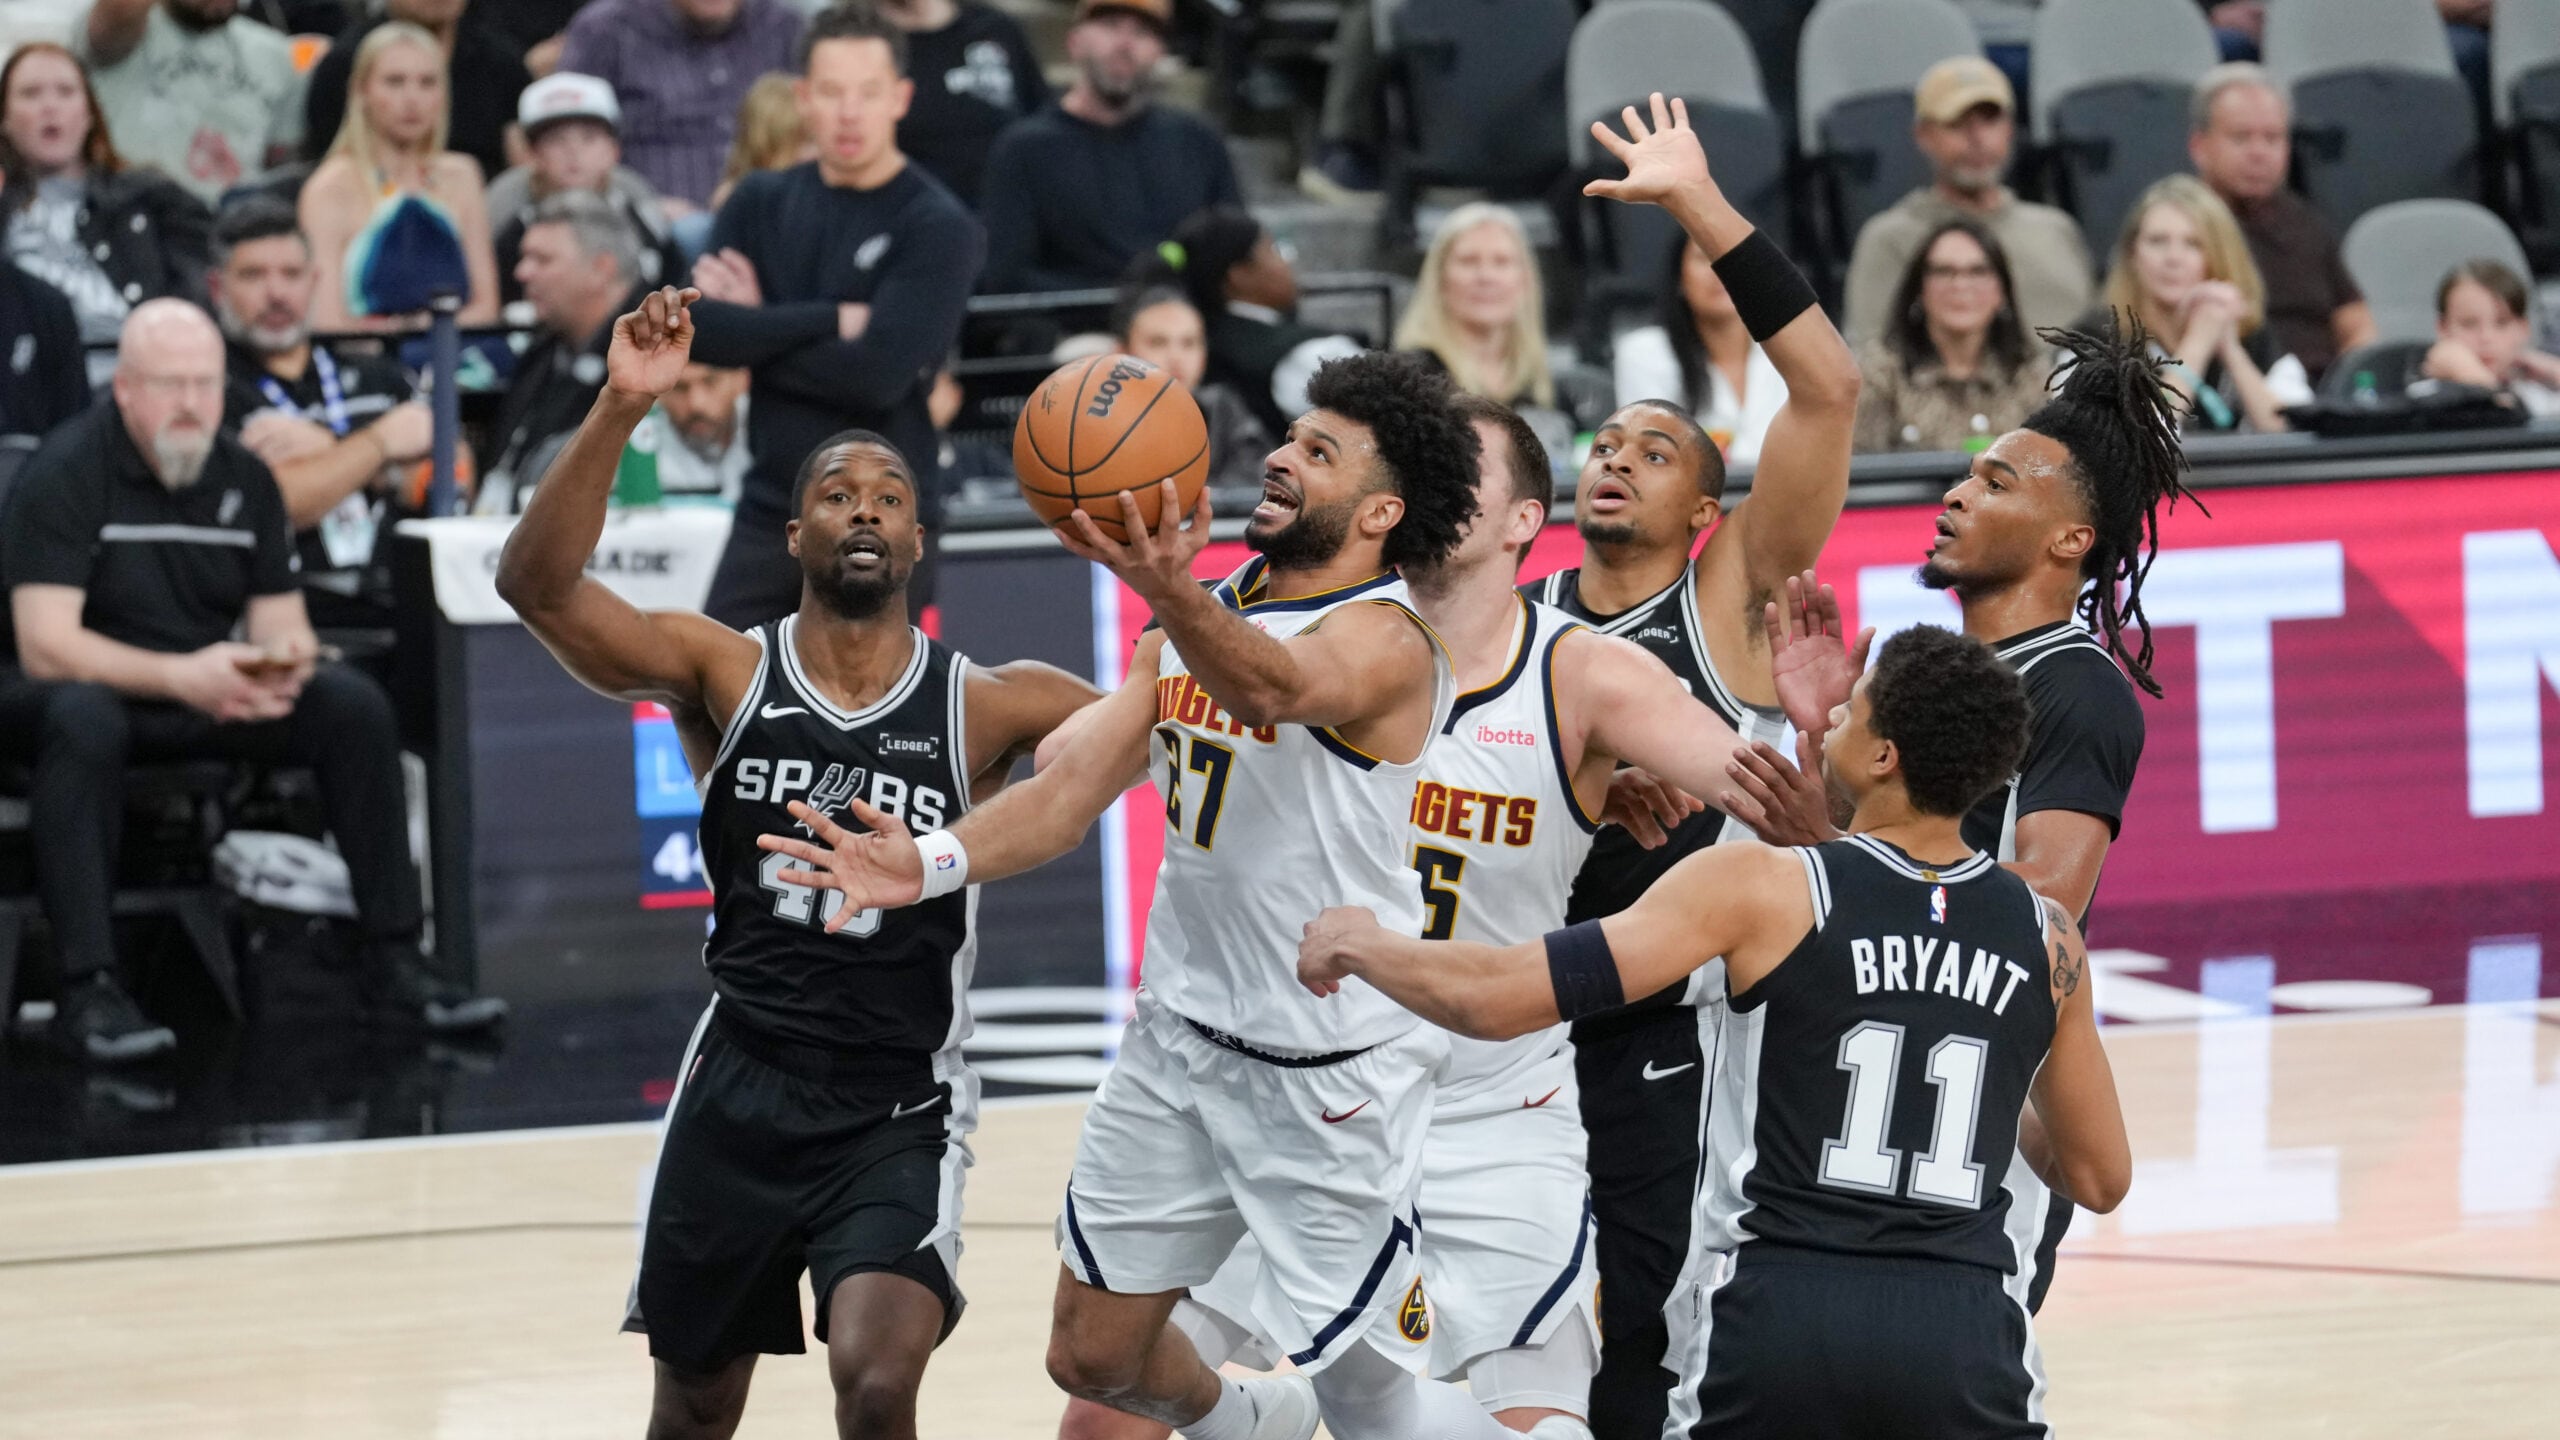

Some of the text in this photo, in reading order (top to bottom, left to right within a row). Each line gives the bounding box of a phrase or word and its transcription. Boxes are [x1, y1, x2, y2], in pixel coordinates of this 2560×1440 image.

[886, 739, 931, 752] LEDGER
[1477, 725, 1536, 747] ibotta
[735, 757, 946, 836] SPURS
[1155, 726, 1236, 852] 27
[1851, 934, 2030, 1016] BRYANT
[1817, 1019, 1989, 1210] 11
